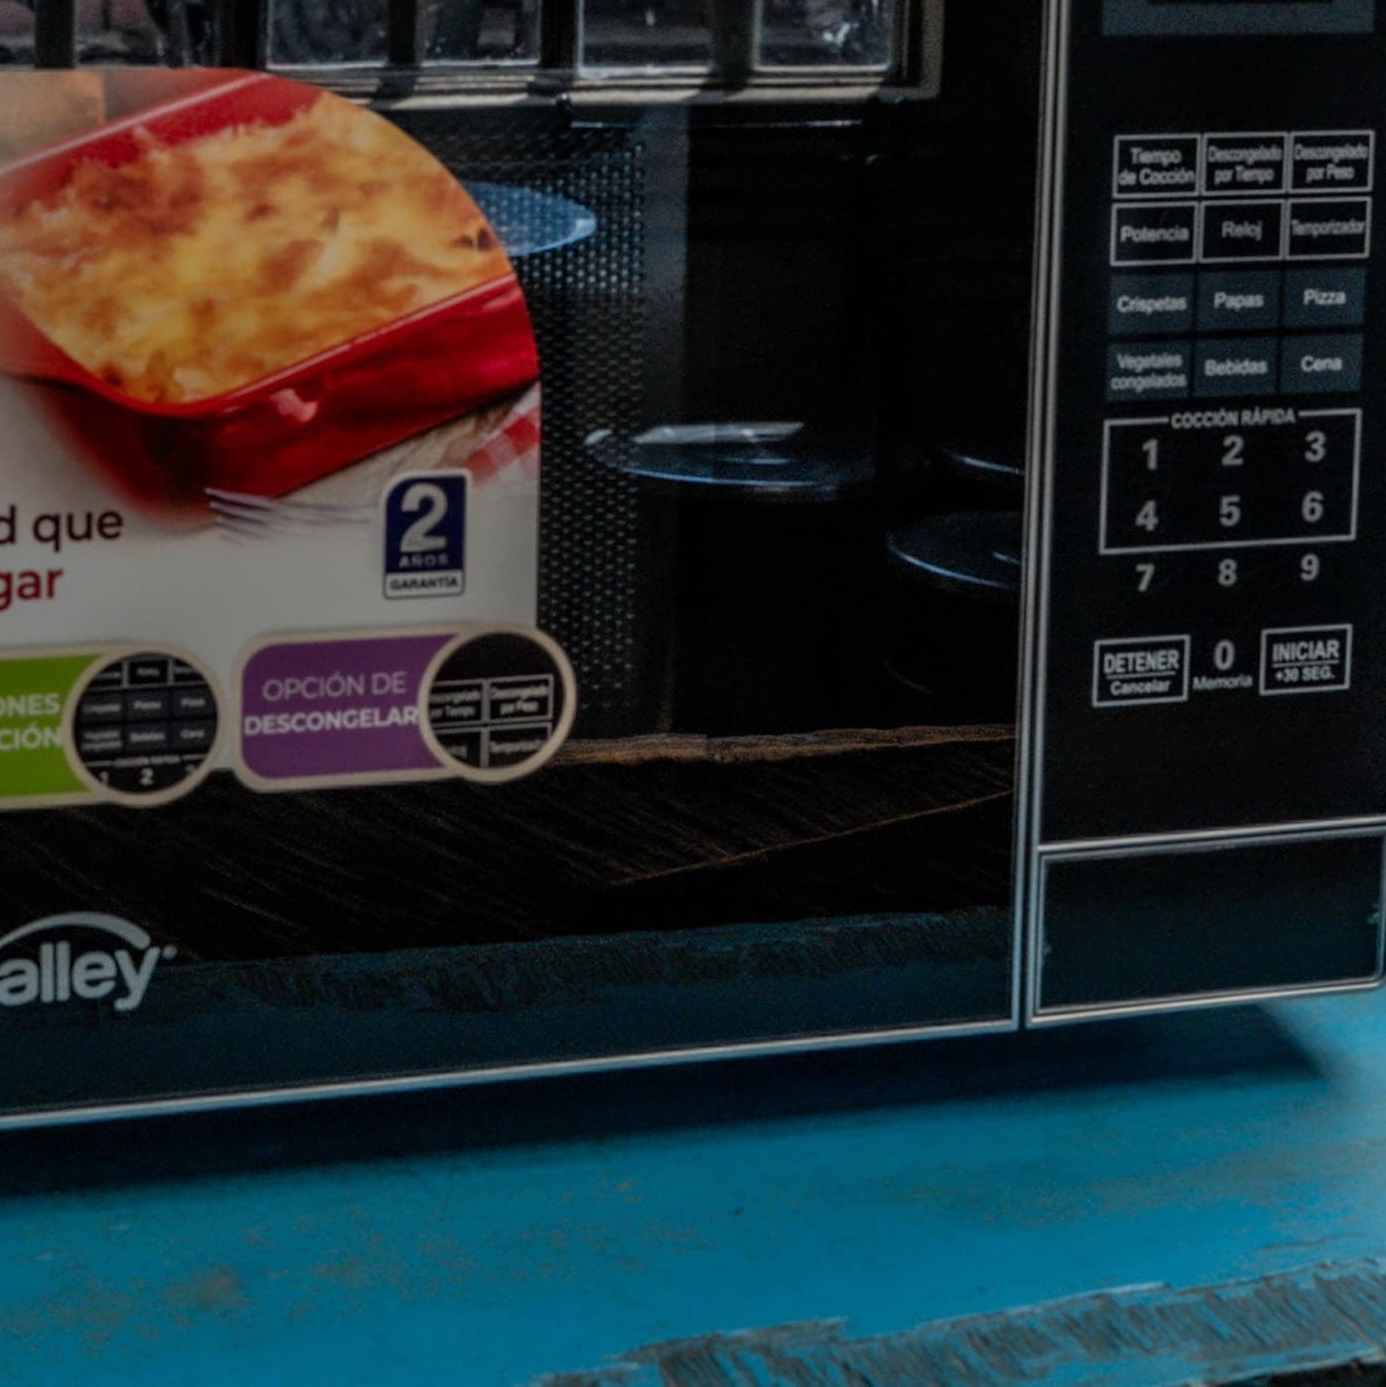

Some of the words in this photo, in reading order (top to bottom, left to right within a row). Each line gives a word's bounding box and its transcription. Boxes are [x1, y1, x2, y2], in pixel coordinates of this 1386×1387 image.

[1130, 146, 1182, 165] Tiempo
[1119, 170, 1137, 186] de
[1139, 166, 1196, 186] Cocción
[1214, 167, 1234, 185] por
[1305, 165, 1325, 182] por
[1326, 164, 1355, 180] Peso
[1120, 223, 1190, 243] Potencia
[1221, 220, 1262, 241] Reloj
[1117, 294, 1188, 315] Crispetas
[1214, 291, 1263, 311] Papas
[1304, 288, 1347, 306] Pizza
[1117, 352, 1184, 372] Vegetales
[1204, 357, 1268, 377] Bebidas
[1301, 355, 1343, 372] Cena
[1111, 372, 1188, 392] congelados
[1171, 408, 1238, 429] COCCIÓN
[1240, 406, 1296, 426] RÁPIDA
[1141, 438, 1159, 470] 1
[1221, 434, 1245, 466] 2
[1304, 430, 1327, 462] 3
[399, 483, 448, 555] 2
[1135, 499, 1159, 532] 4
[1219, 495, 1241, 526] 5
[1301, 490, 1324, 523] 6
[32, 508, 125, 552] que
[399, 551, 449, 570] AÑOS
[1135, 563, 1156, 593] 7
[1217, 558, 1238, 587] 8
[1299, 553, 1320, 582] 9
[389, 575, 460, 592] GARANTÍA
[1214, 639, 1235, 671] 0
[1271, 638, 1341, 662] INICIAR
[1103, 648, 1180, 674] DETENER
[1192, 673, 1253, 691] Memoria
[1274, 666, 1300, 683] +30
[1301, 664, 1336, 682] SEG.
[262, 669, 364, 703] OPCIÓN
[371, 670, 408, 696] DE
[1110, 678, 1171, 696] Cancelar
[243, 703, 420, 737] DESCONGELAR
